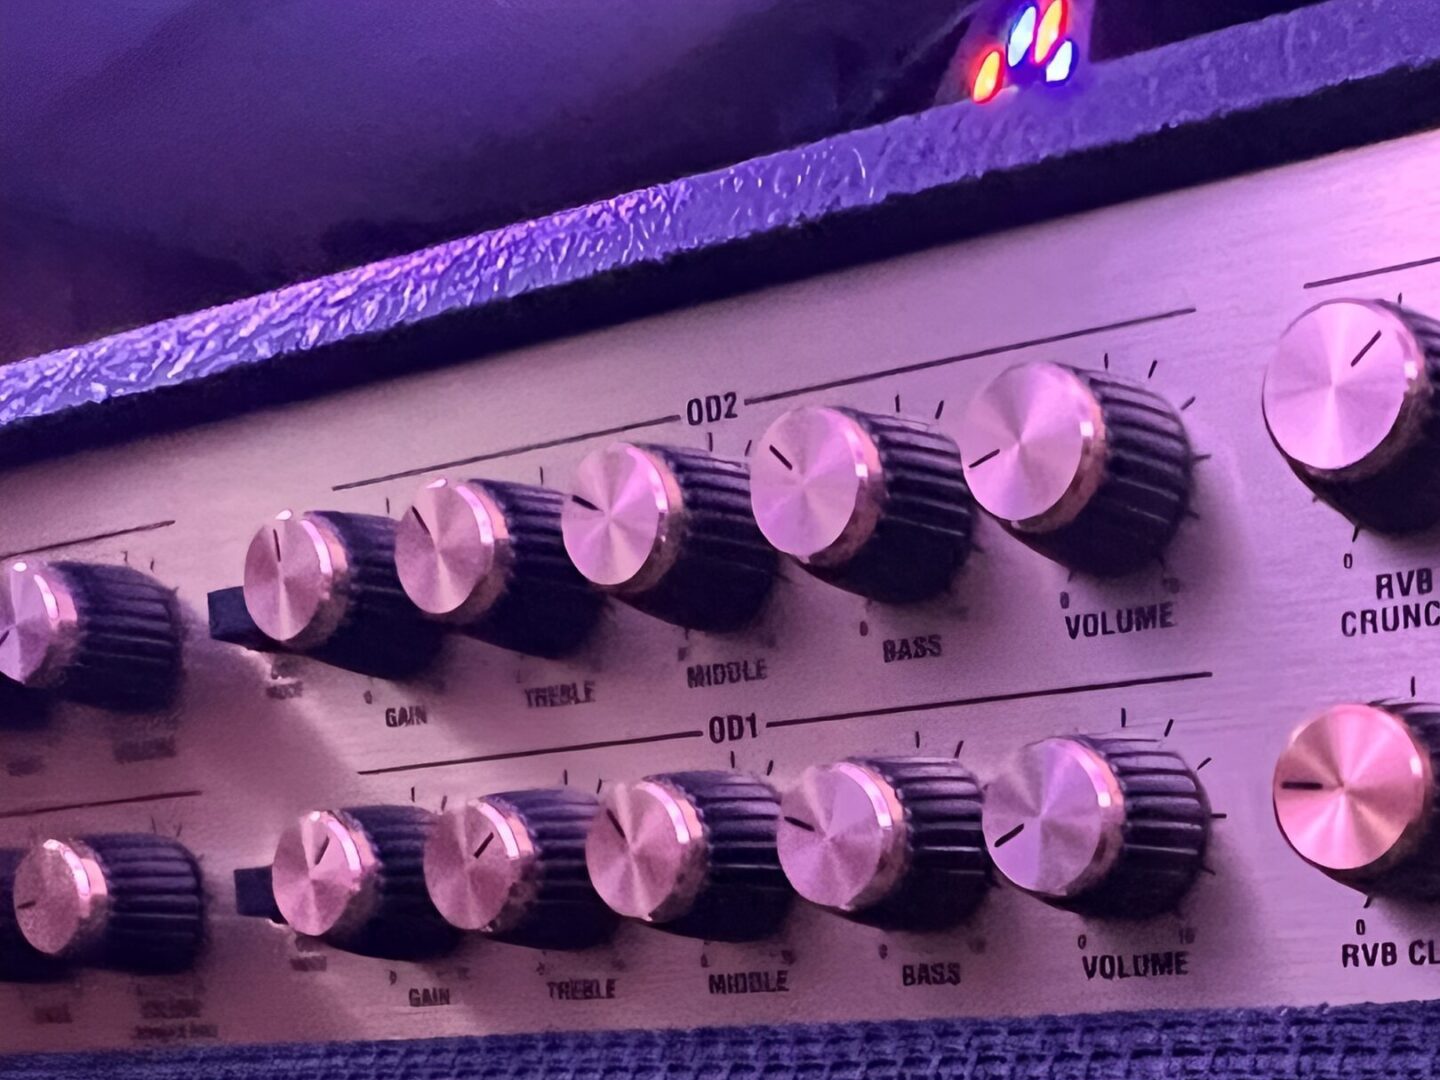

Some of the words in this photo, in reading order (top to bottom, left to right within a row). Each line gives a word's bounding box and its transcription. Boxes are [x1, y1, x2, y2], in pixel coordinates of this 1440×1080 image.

[687, 392, 738, 426] OD2
[1344, 553, 1353, 569] 0
[1376, 568, 1433, 600] RVB
[1065, 601, 1177, 640] VOLUME
[883, 634, 942, 663] BASS
[687, 659, 768, 688] MIDDLE
[385, 705, 428, 727] GAIN
[709, 712, 758, 744] OD1
[1356, 919, 1366, 936] 0
[1082, 951, 1189, 980] VOLUME
[1342, 941, 1397, 968] RVB
[708, 970, 790, 994] MIDDLE
[902, 962, 961, 986] BASS
[409, 988, 451, 1007] GAIN
[546, 978, 617, 1000] TREBLE
